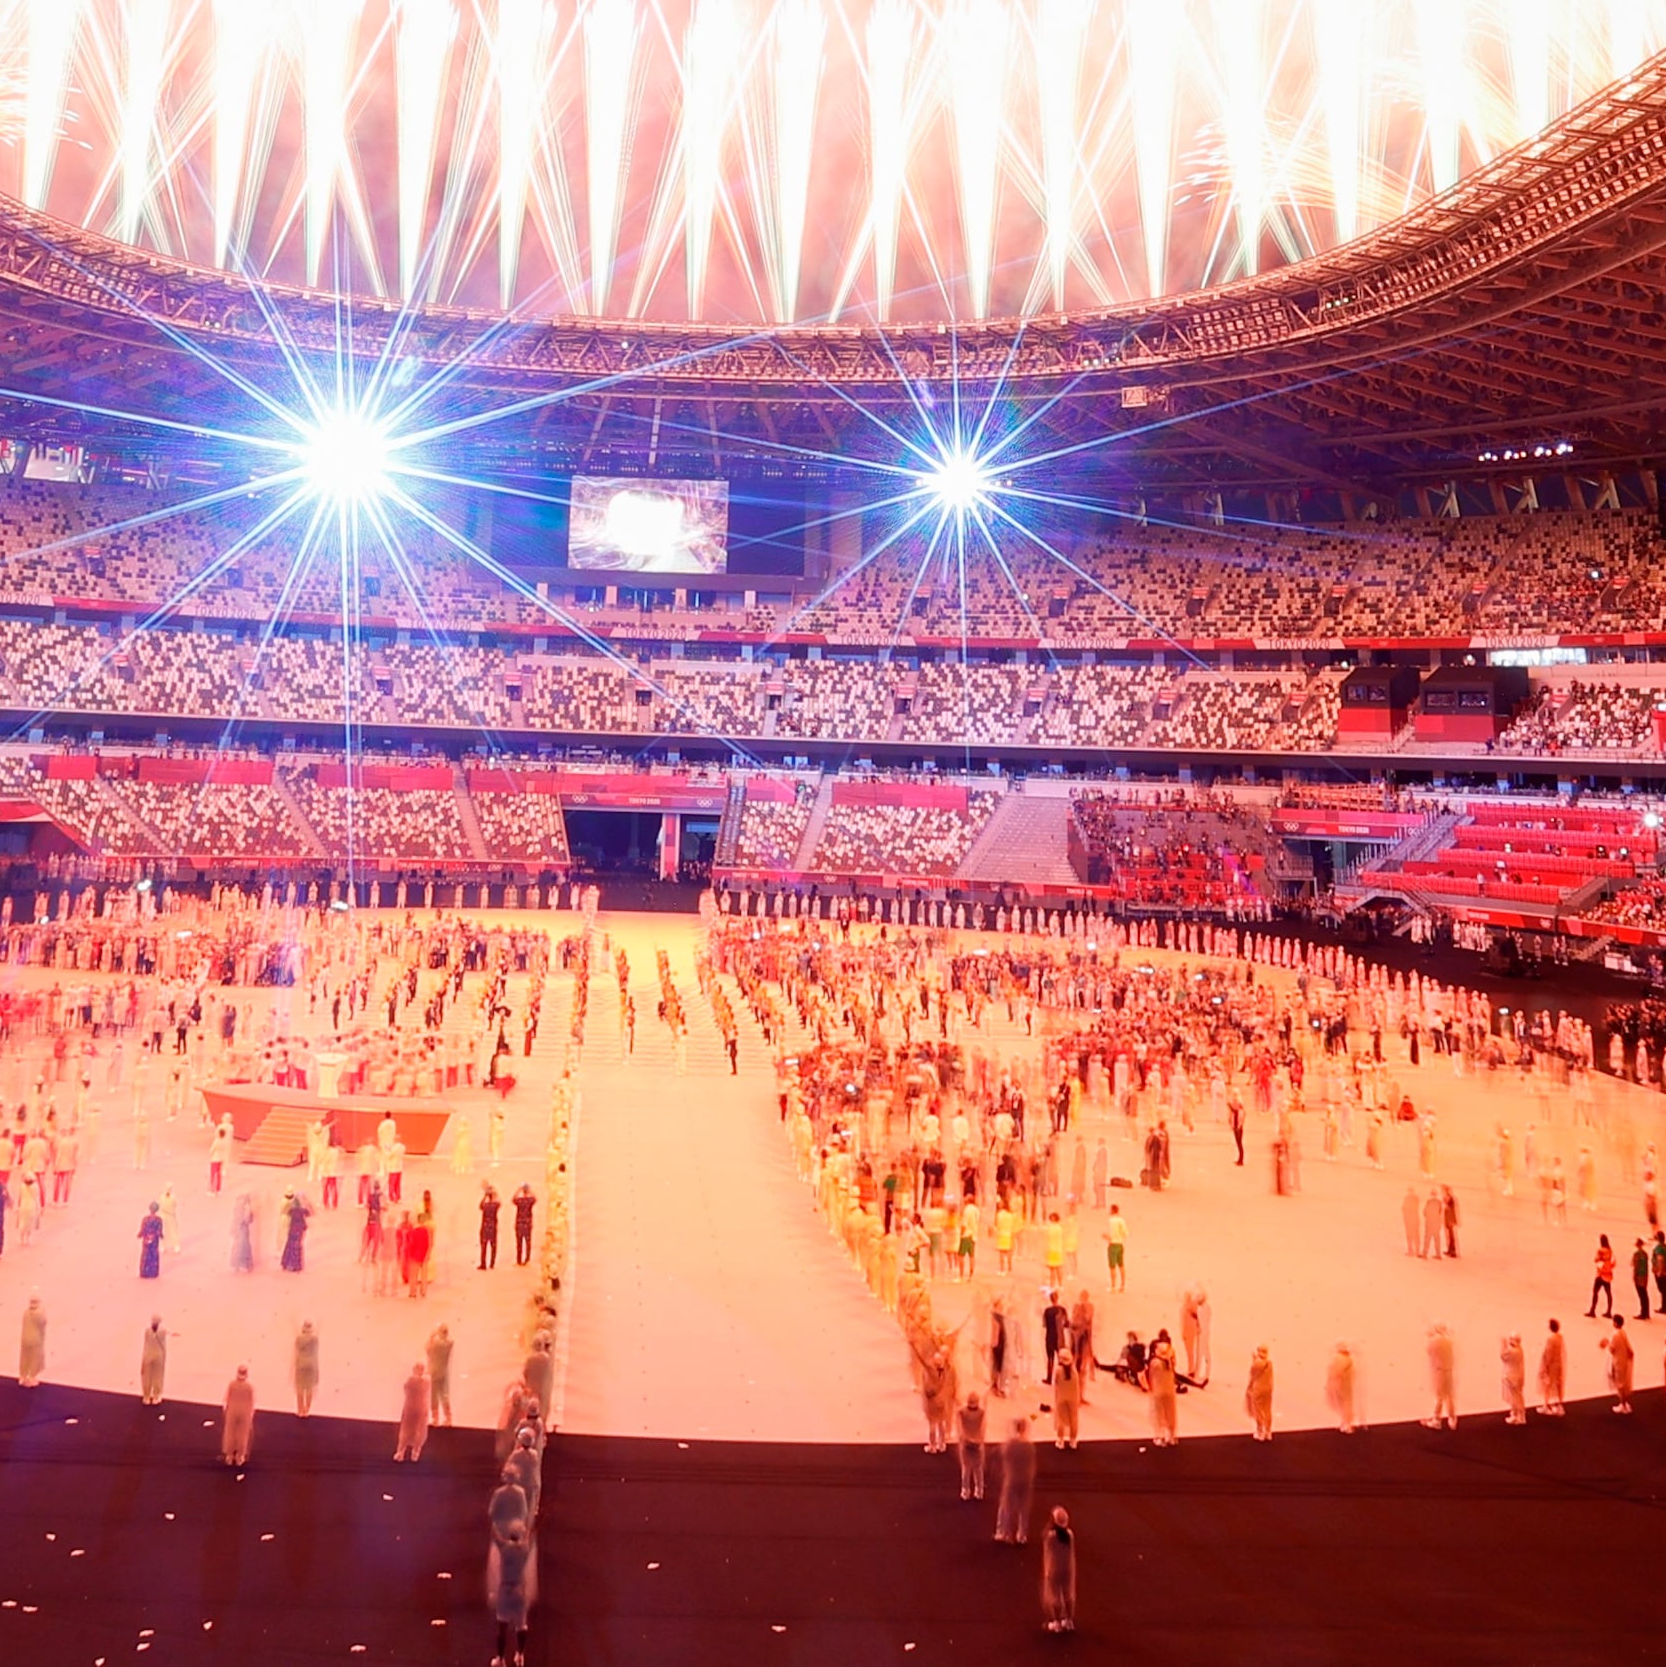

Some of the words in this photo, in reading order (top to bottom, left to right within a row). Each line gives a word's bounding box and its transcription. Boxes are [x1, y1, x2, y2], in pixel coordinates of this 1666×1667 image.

[1054, 638, 1088, 649] TOKYO
[1090, 638, 1115, 649] 2020
[1268, 638, 1303, 650] TOKYO
[1304, 638, 1331, 650] 2020
[1485, 636, 1521, 648] TOKYO
[1522, 635, 1546, 647] 2020
